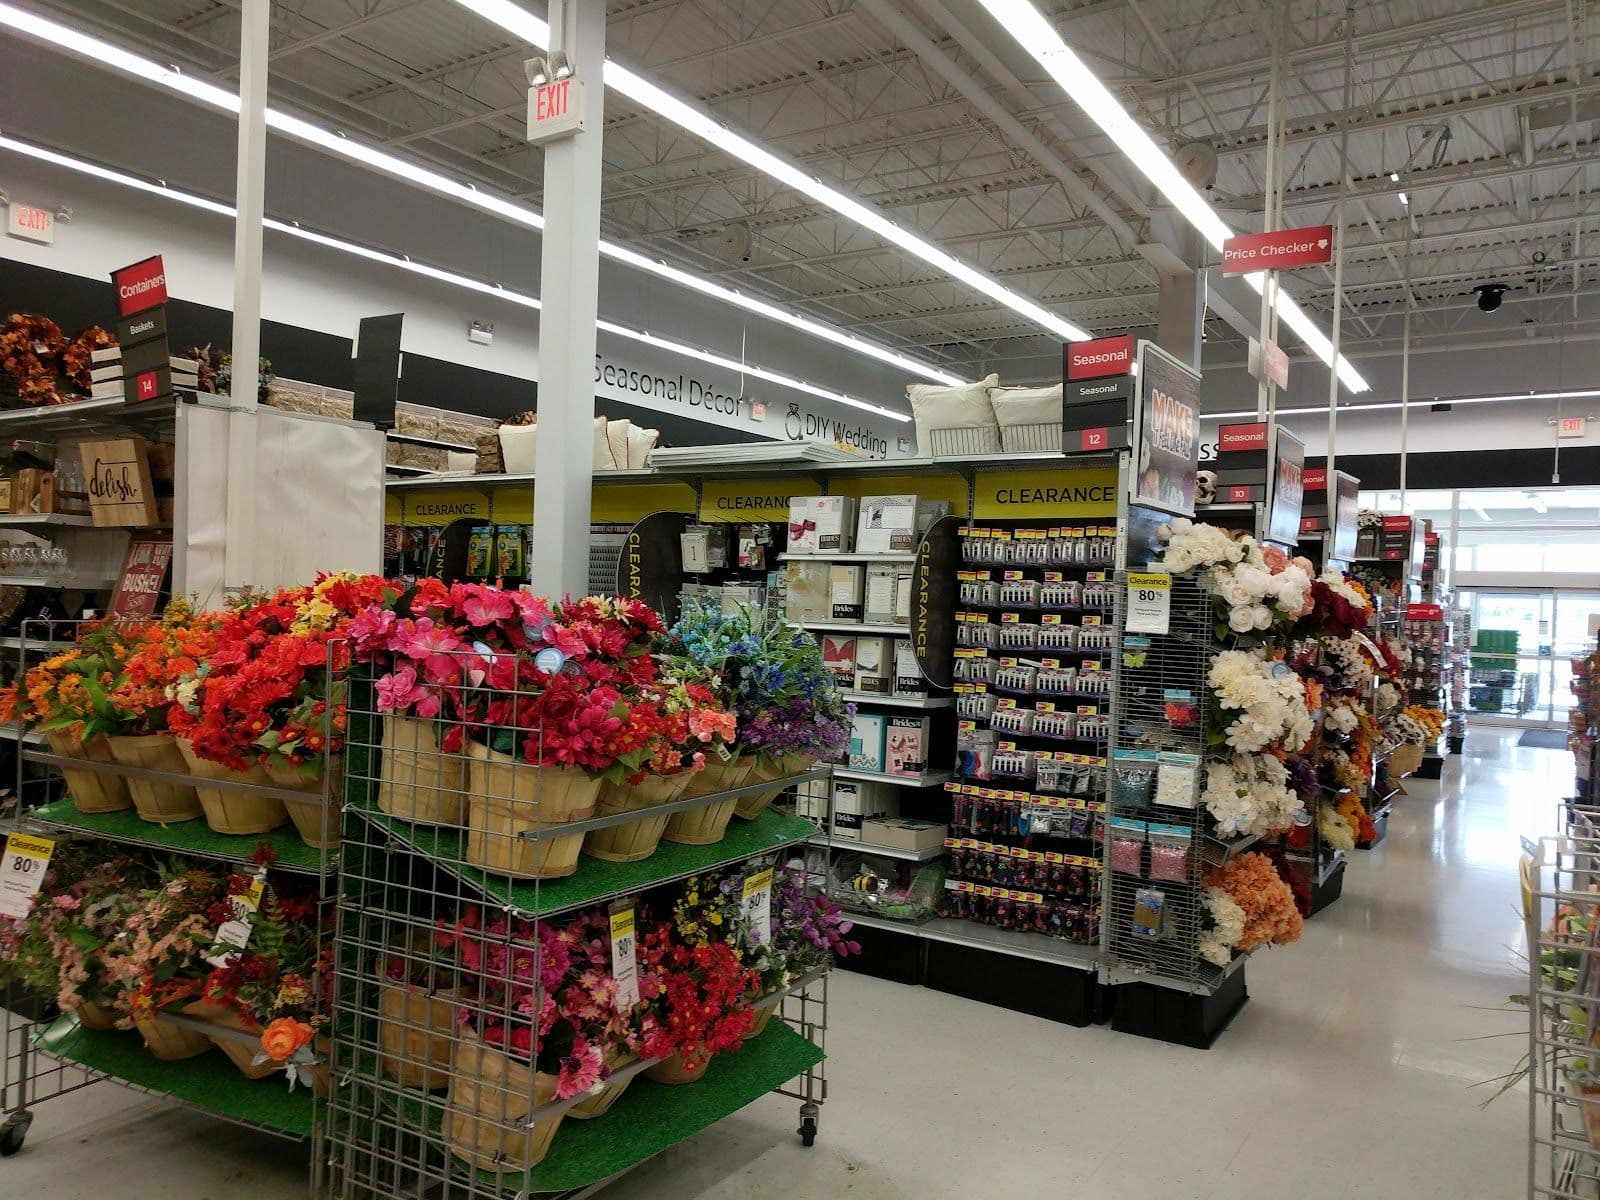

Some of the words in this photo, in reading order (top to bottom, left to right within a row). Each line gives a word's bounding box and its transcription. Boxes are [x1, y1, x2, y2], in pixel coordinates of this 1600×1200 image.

[537, 80, 570, 121] EXIT
[18, 207, 47, 231] EXIT
[1224, 249, 1256, 261] Price
[1260, 242, 1315, 257] Checker
[120, 274, 166, 299] Containers
[130, 320, 155, 335] Baskets
[1073, 348, 1128, 366] Seasonal
[143, 380, 153, 393] 14
[1079, 384, 1118, 396] Seasonal
[689, 380, 743, 417] Décor
[1562, 419, 1581, 431] EXIT
[806, 413, 830, 439] DIY
[833, 420, 887, 460] Wedding
[1088, 434, 1101, 445] 12
[1223, 432, 1264, 443] Seasonal
[996, 486, 1115, 504] CLEARANCE
[1234, 490, 1244, 498] 10
[415, 503, 477, 516] CLEARANCE
[1129, 576, 1168, 586] Clearance
[917, 540, 931, 658] CLEARANCE
[893, 718, 916, 728] Brides
[9, 836, 51, 854] Clearance
